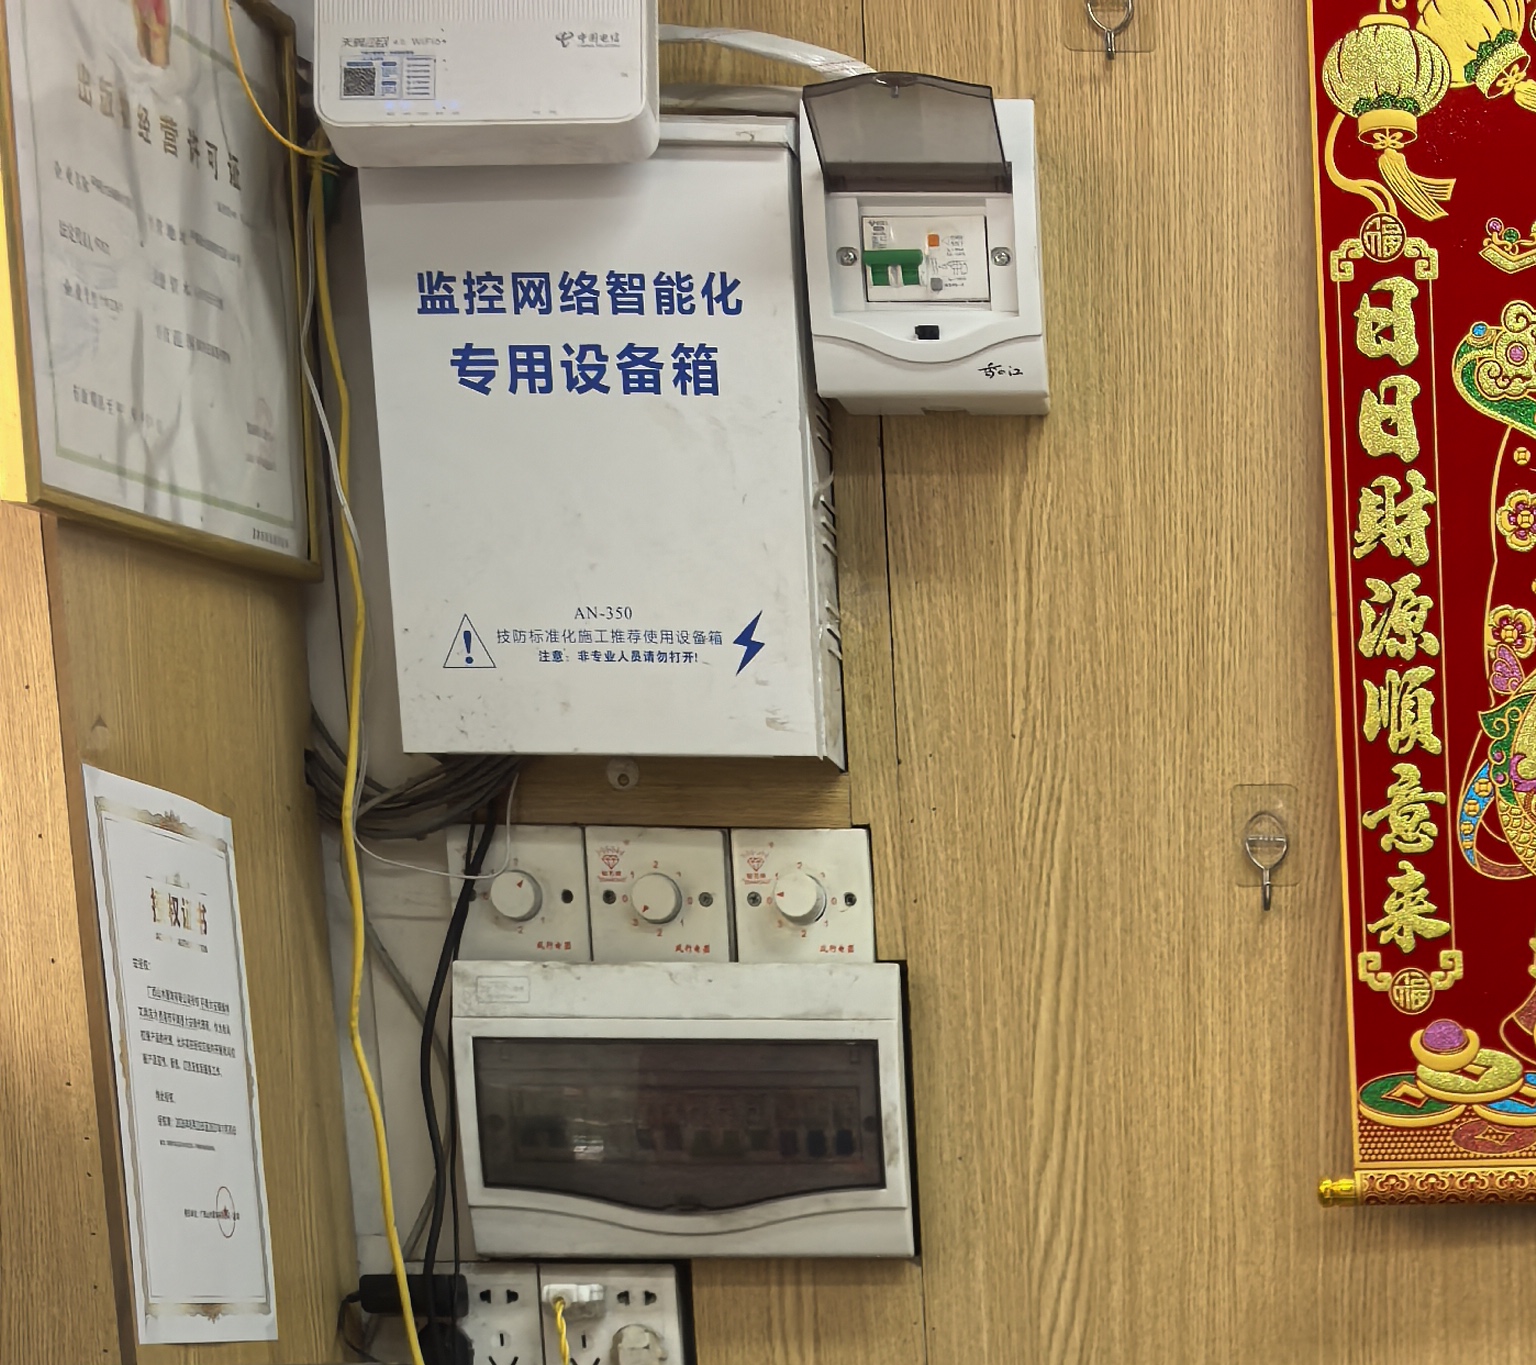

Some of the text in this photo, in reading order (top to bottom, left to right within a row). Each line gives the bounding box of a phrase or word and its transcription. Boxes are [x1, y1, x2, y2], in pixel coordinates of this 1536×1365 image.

[416, 271, 744, 317] 监控网络智能化
[449, 342, 722, 398] 专用设备箱
[573, 605, 634, 621] AN-350
[496, 627, 724, 646] 技防标准化施工推荐使用设备箱
